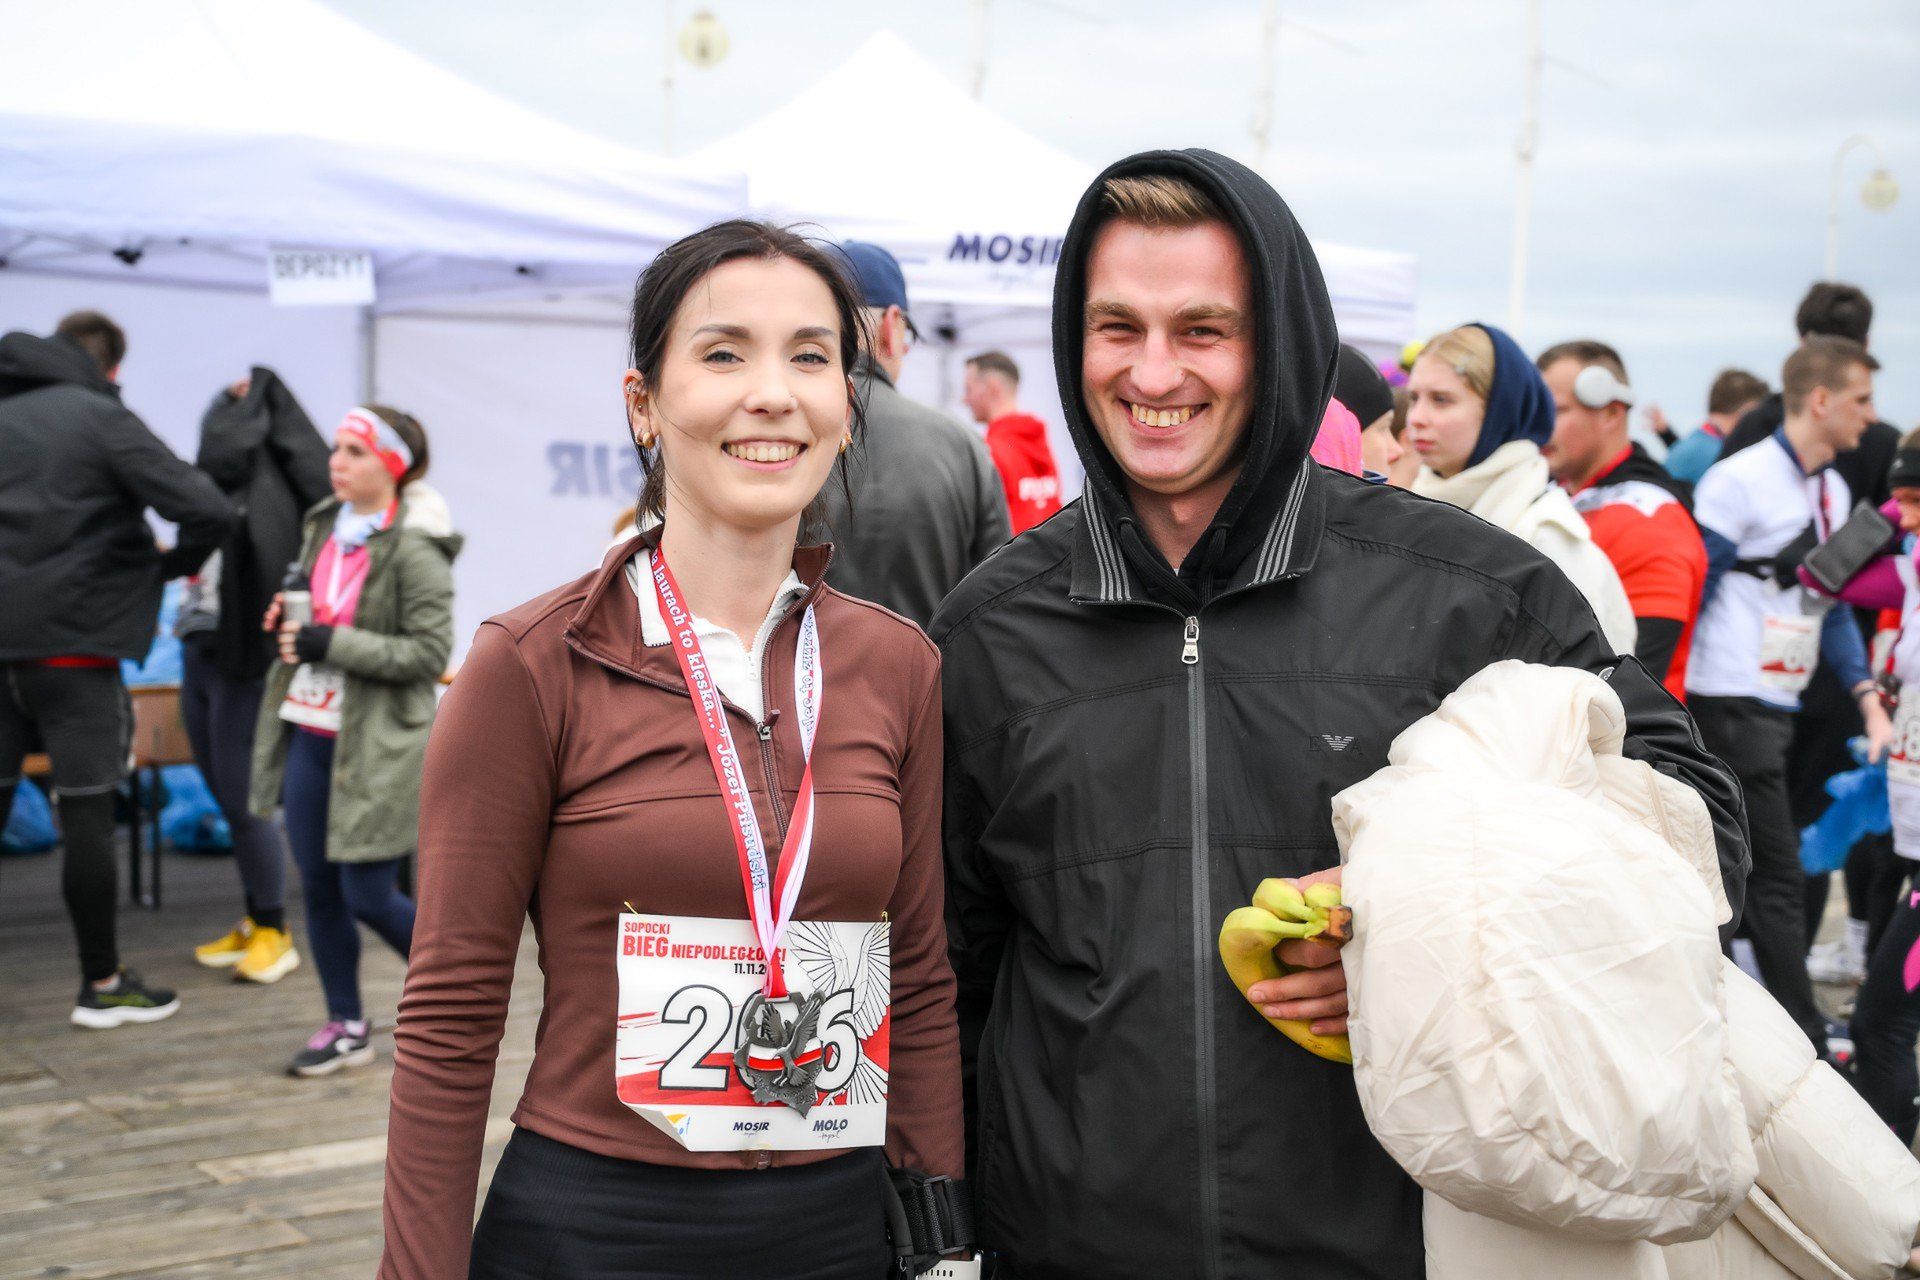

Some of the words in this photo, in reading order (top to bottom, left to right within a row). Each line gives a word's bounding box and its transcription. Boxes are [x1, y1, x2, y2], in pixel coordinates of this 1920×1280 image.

[800, 675, 814, 694] to
[654, 564, 687, 626] laurach
[679, 629, 694, 648] to
[717, 743, 745, 796] Józef
[733, 800, 767, 892] Piłsudski
[624, 921, 671, 935] SOPOCKI
[623, 935, 669, 958] BIEG
[671, 943, 787, 962] NIEPODLEGŁOI
[733, 1121, 770, 1131] MOSIR
[812, 1118, 848, 1132] MOLO
